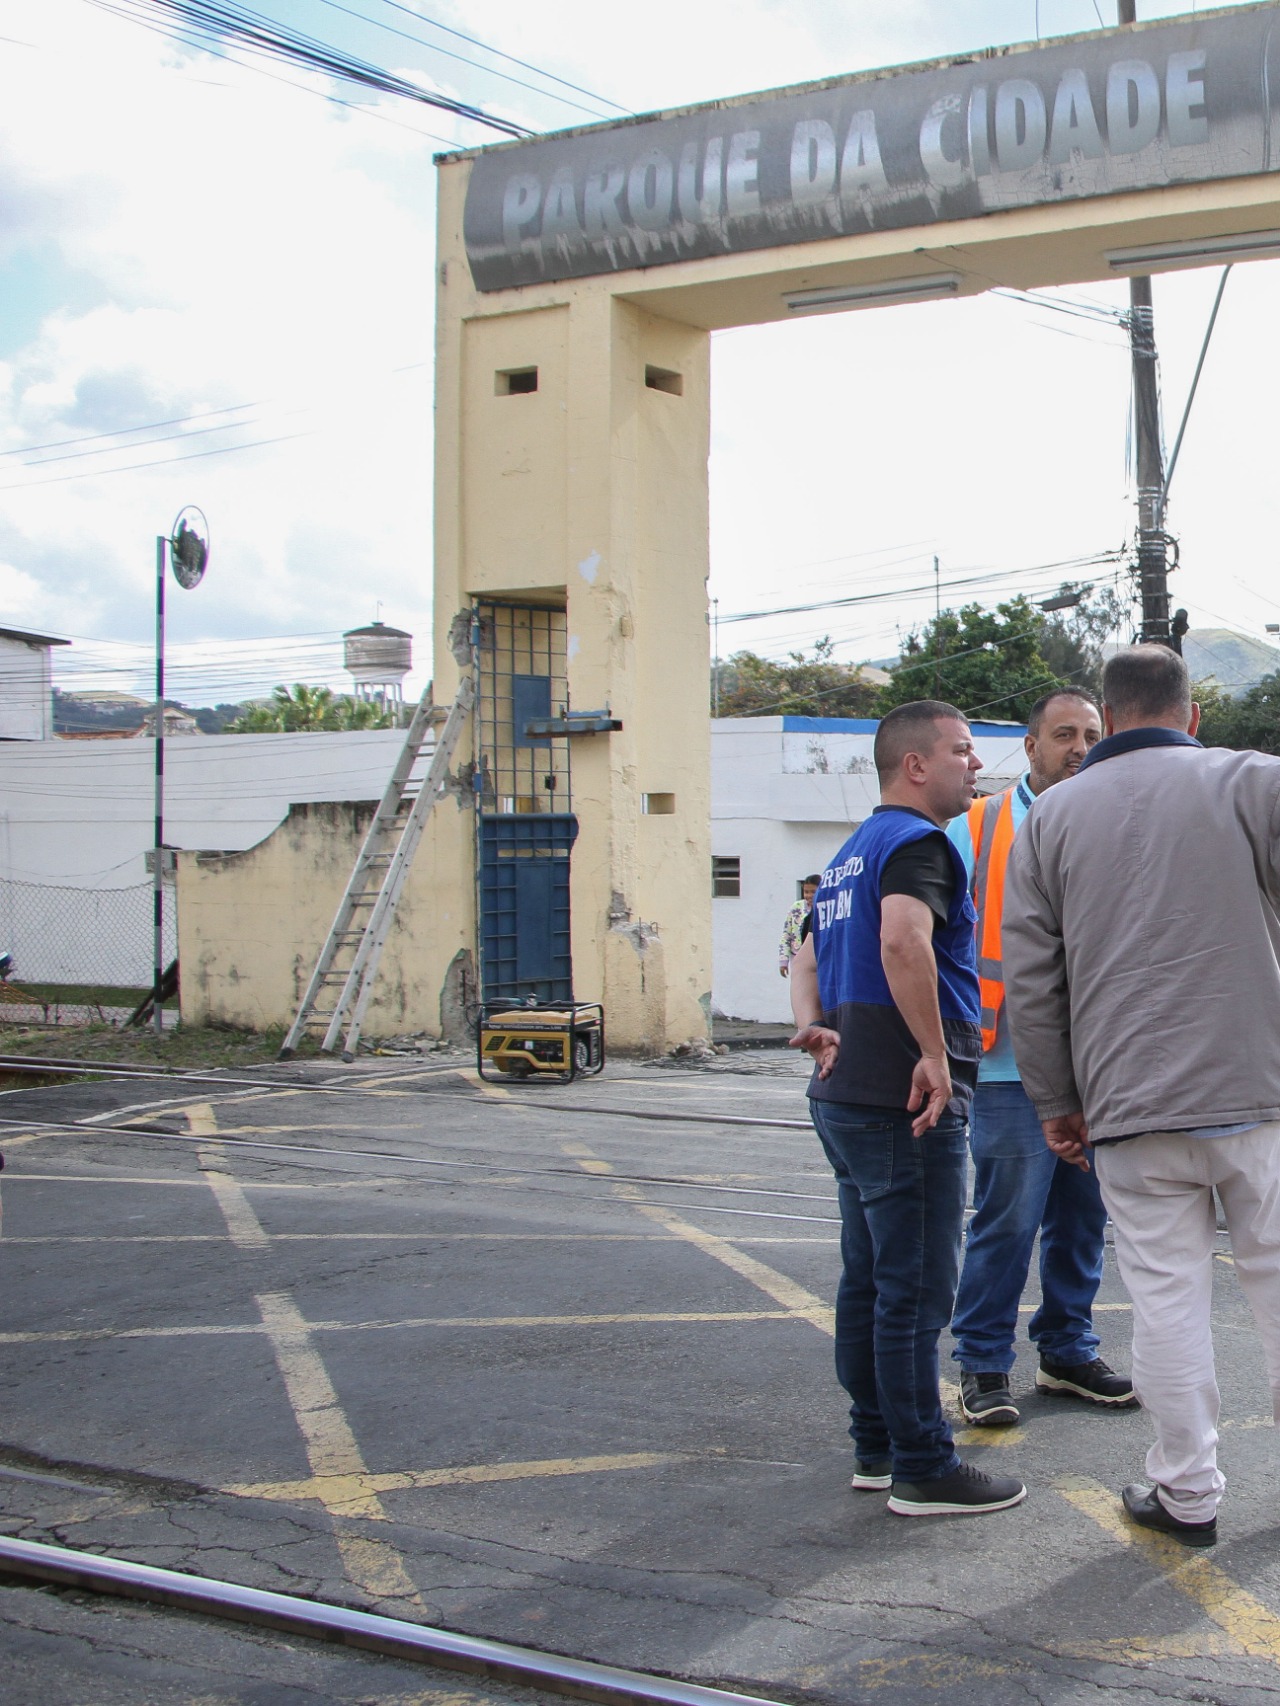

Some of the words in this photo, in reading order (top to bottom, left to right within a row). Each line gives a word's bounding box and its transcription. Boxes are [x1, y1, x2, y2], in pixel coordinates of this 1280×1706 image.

[502, 130, 762, 252] PARQUE
[790, 108, 890, 210] DA
[919, 49, 1209, 188] CIDADE
